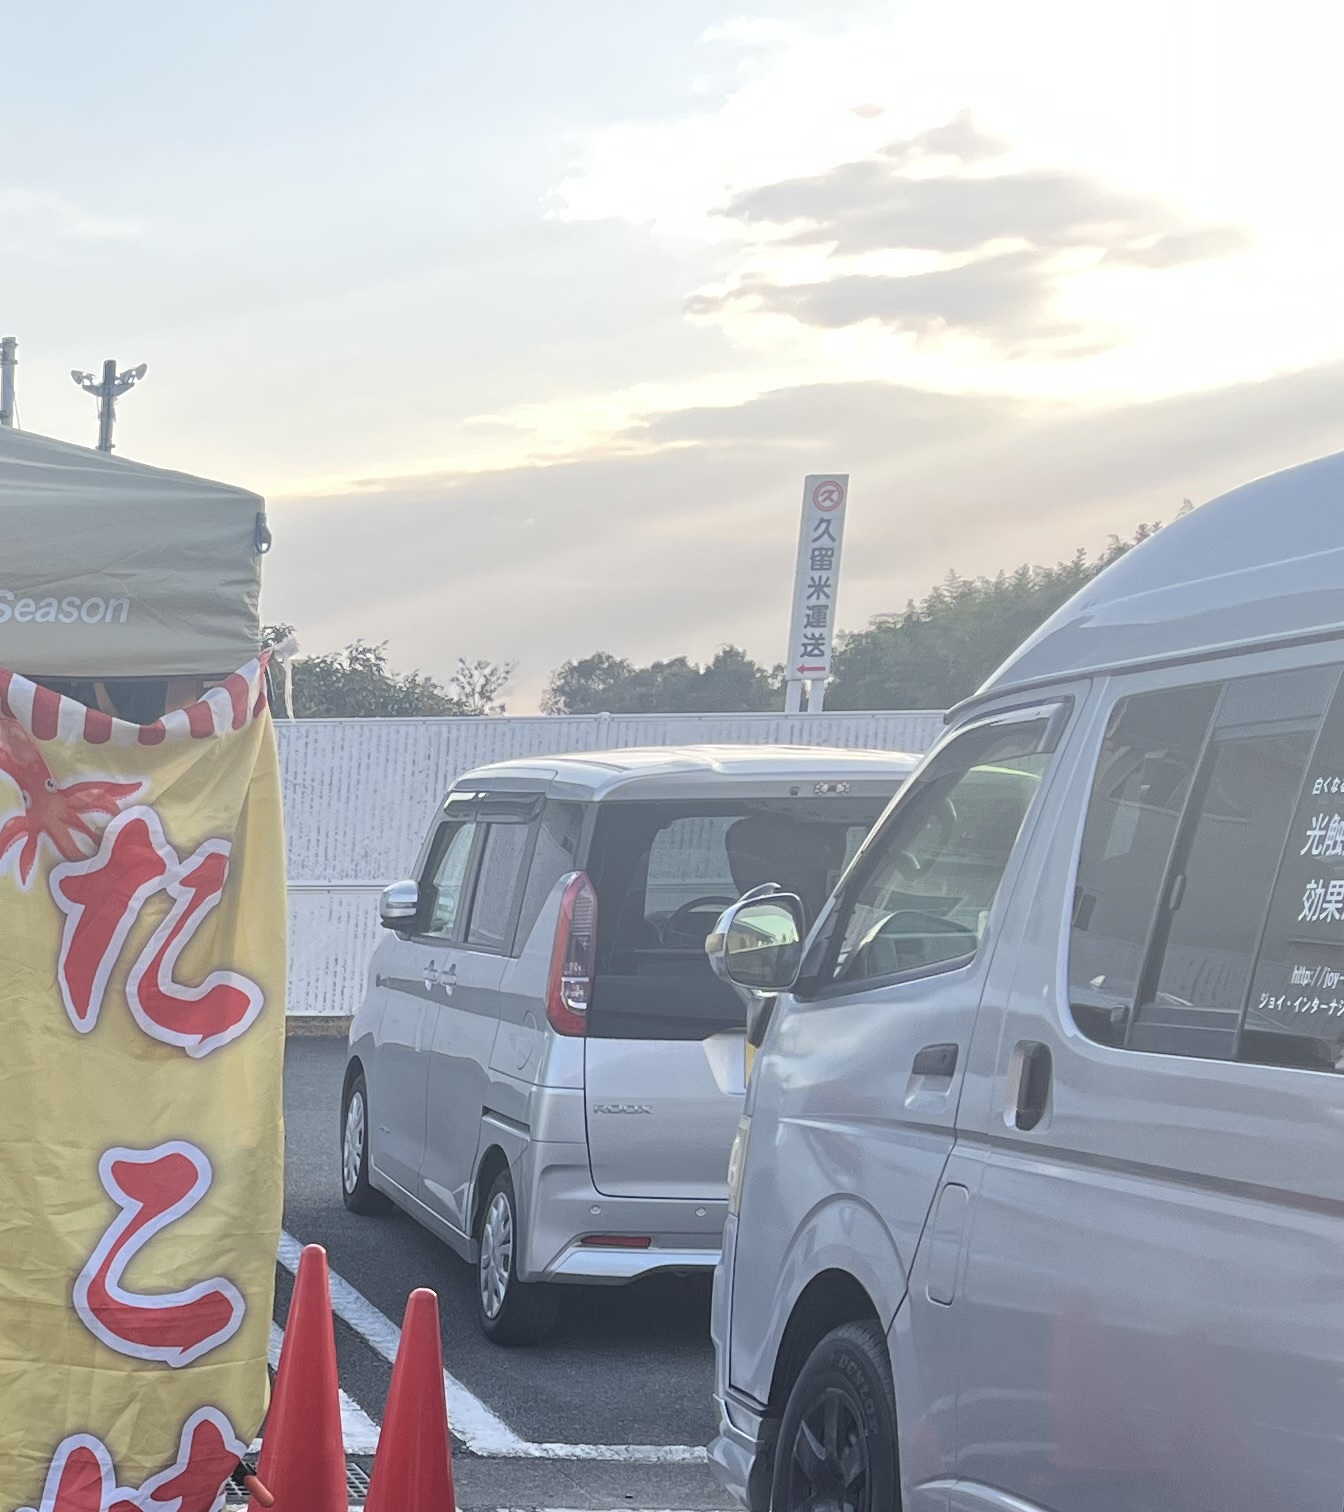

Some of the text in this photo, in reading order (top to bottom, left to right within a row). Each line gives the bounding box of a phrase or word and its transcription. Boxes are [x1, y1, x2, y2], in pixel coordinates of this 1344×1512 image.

[800, 517, 837, 658] 久留米運送
[1298, 879, 1344, 922] 効果
